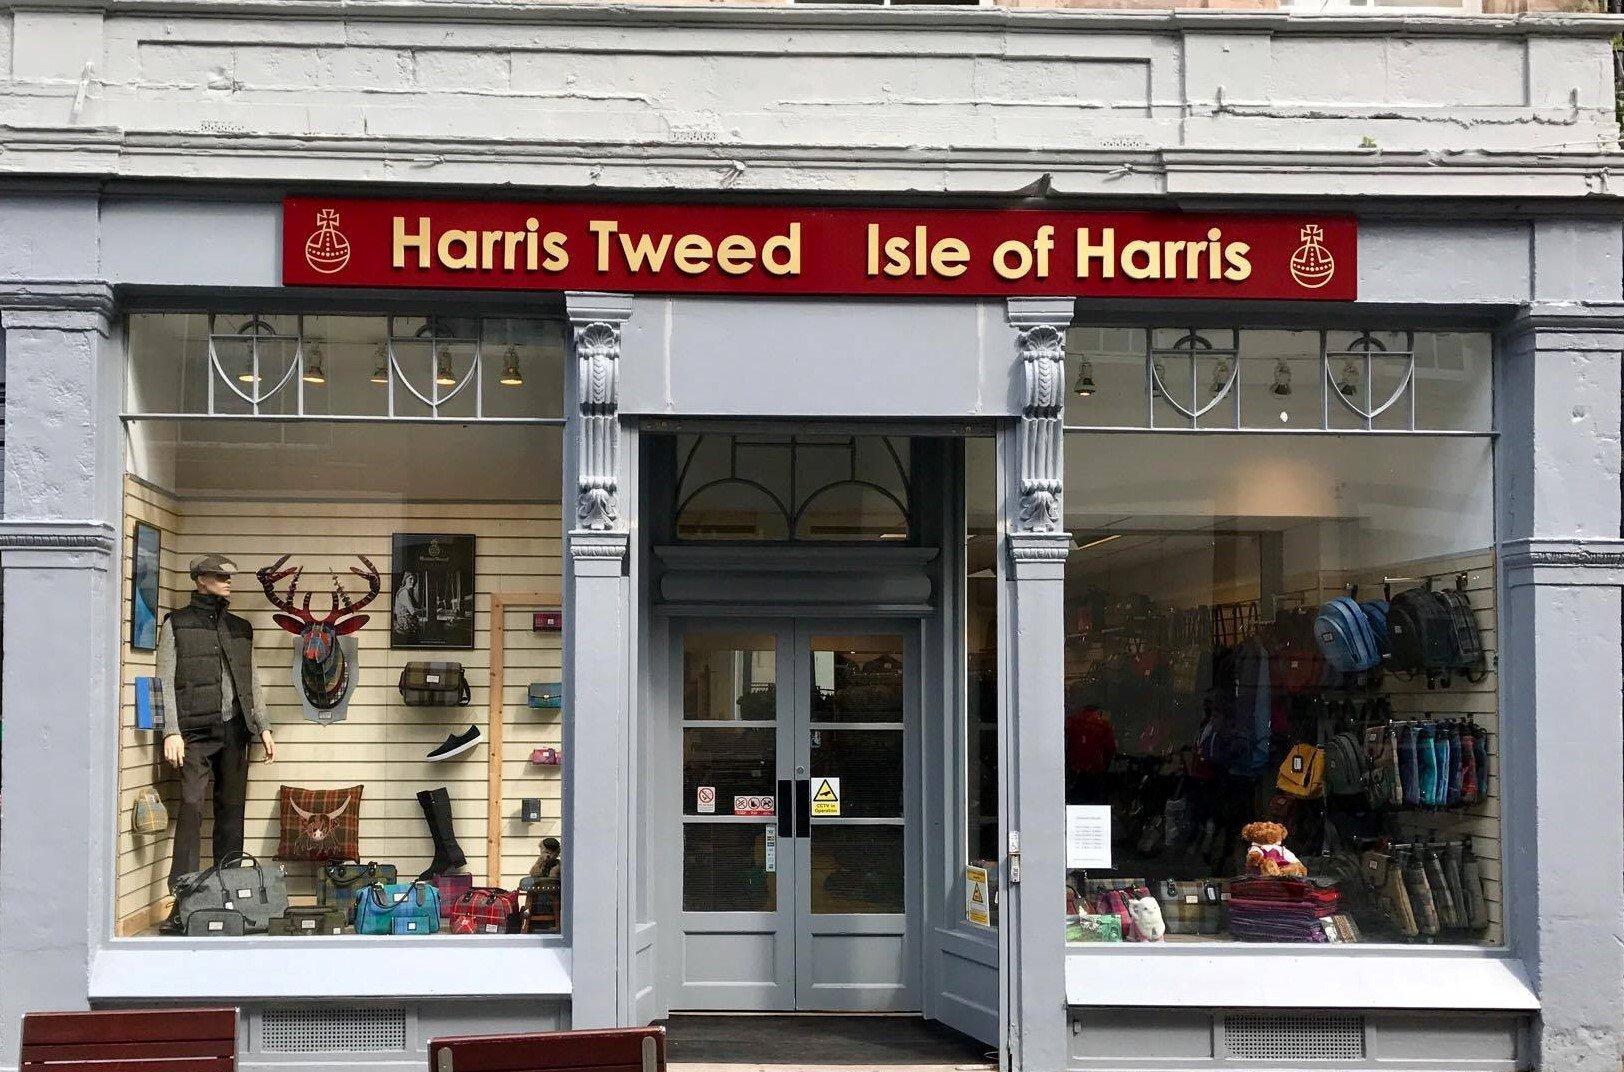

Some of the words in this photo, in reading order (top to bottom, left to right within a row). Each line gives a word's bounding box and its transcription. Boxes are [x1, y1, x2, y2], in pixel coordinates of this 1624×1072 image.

[391, 216, 569, 272] Harris
[589, 220, 802, 275] Tweed
[867, 223, 971, 278] Isle
[992, 225, 1055, 280] of
[1076, 227, 1252, 281] Harris
